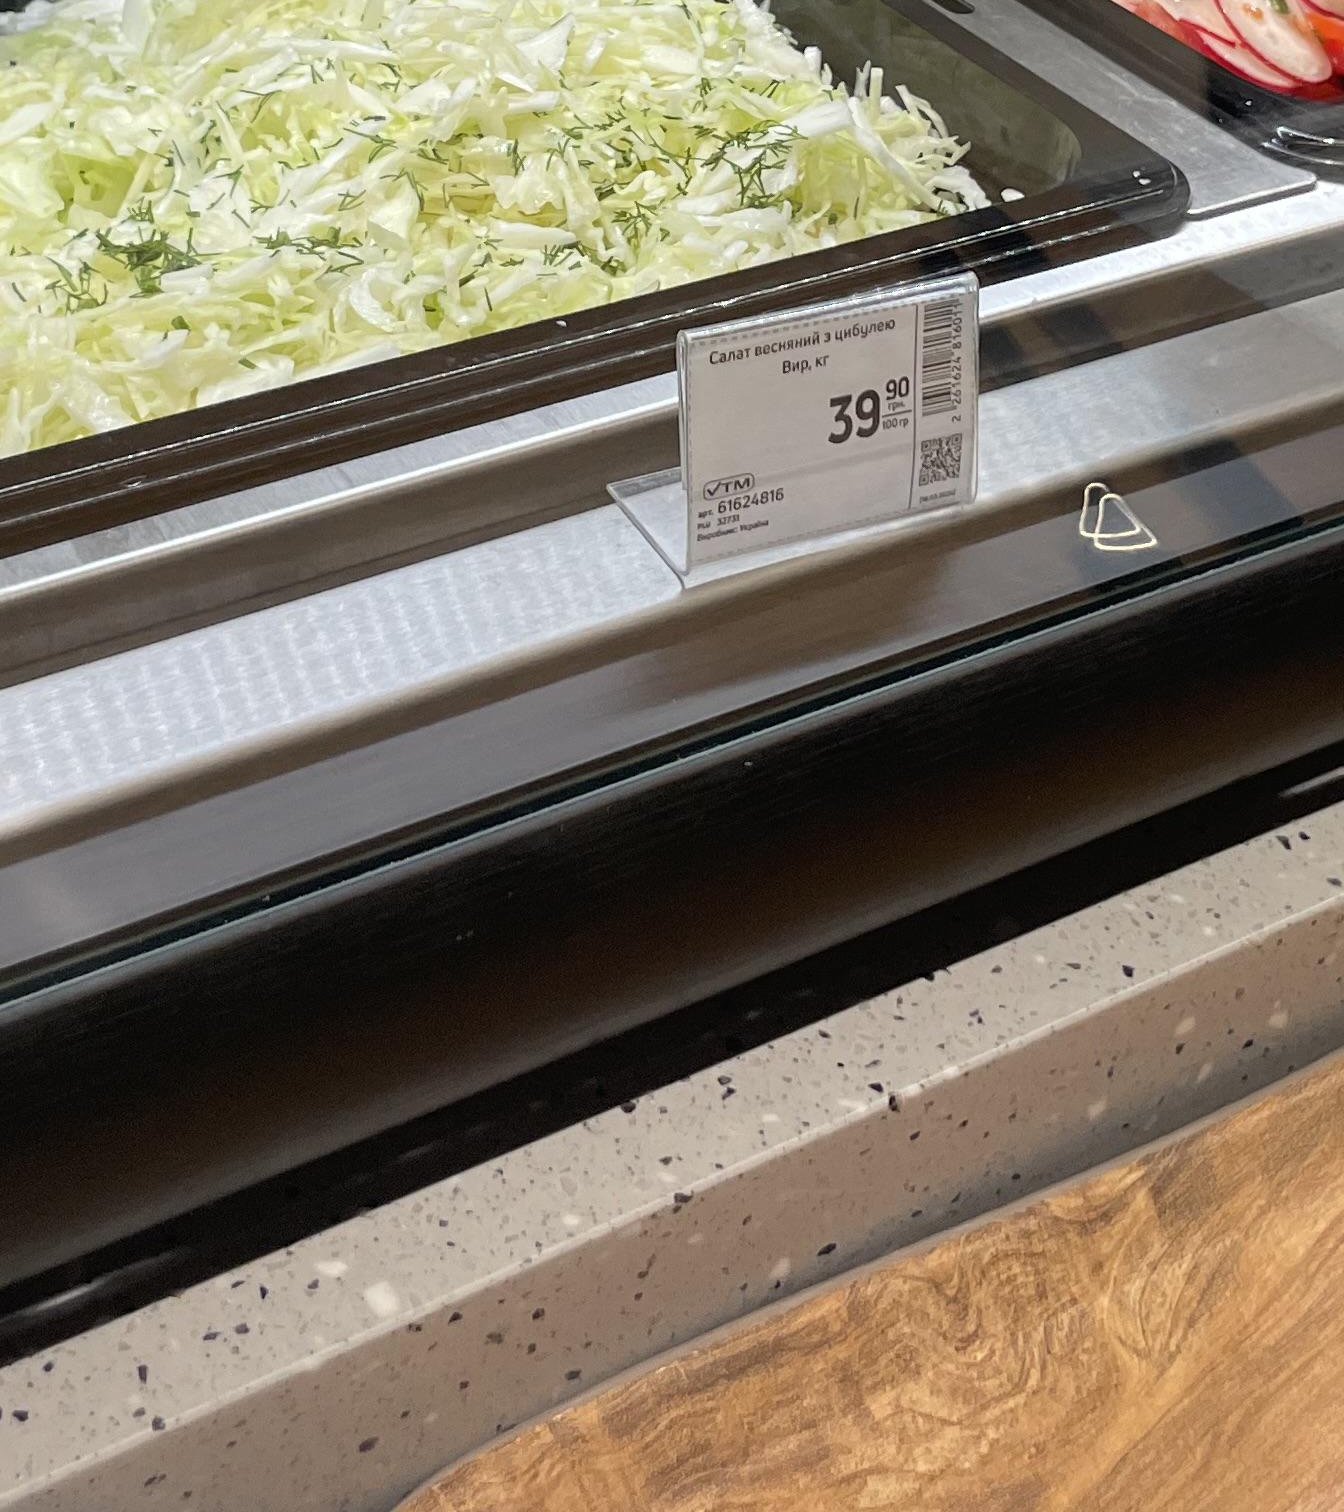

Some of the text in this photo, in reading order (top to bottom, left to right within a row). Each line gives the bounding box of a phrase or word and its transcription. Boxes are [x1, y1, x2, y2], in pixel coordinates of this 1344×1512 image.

[709, 318, 896, 365] Салат весняний з цибулею
[782, 354, 830, 375] Вир, кг
[885, 376, 910, 400] 90
[828, 389, 881, 445] 39
[883, 418, 898, 431] 100
[717, 488, 785, 515] 61624816
